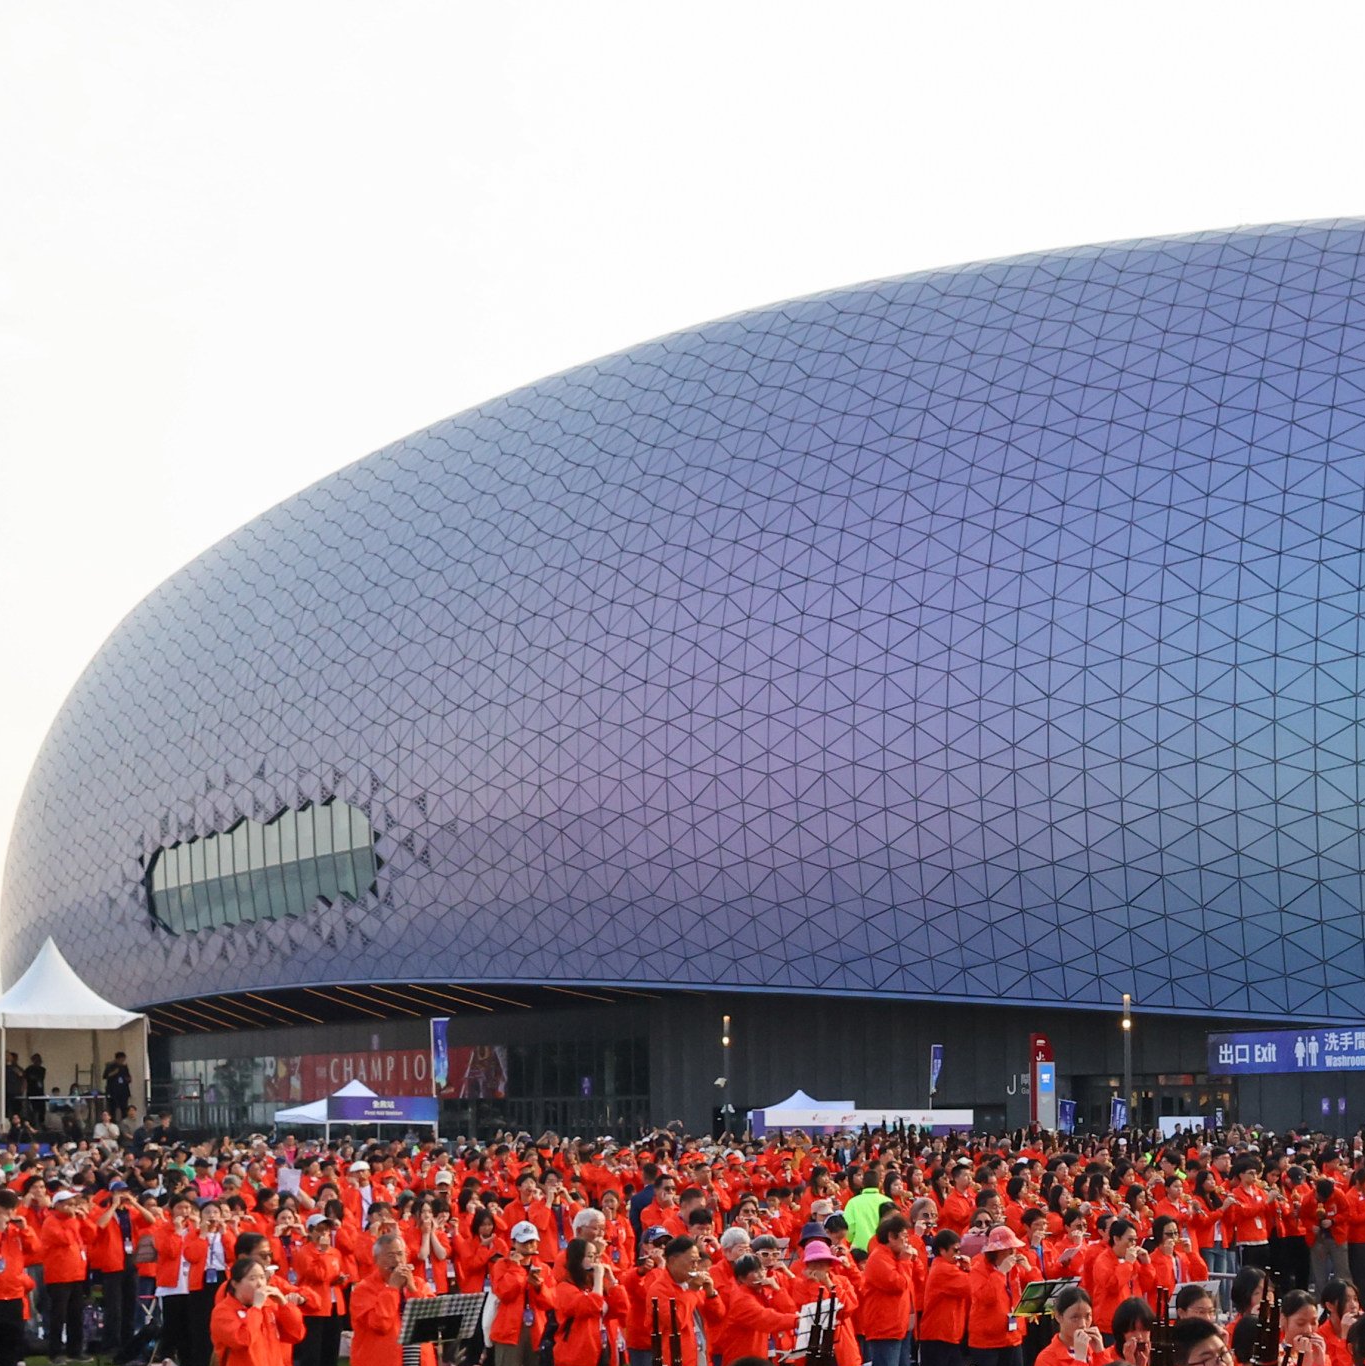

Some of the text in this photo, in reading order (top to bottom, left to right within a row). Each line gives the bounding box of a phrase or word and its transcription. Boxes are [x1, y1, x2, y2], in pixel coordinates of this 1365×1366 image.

[1218, 1043, 1277, 1065] 出口 Exit
[330, 1054, 433, 1083] CHAMPIO
[1006, 1074, 1016, 1095] J
